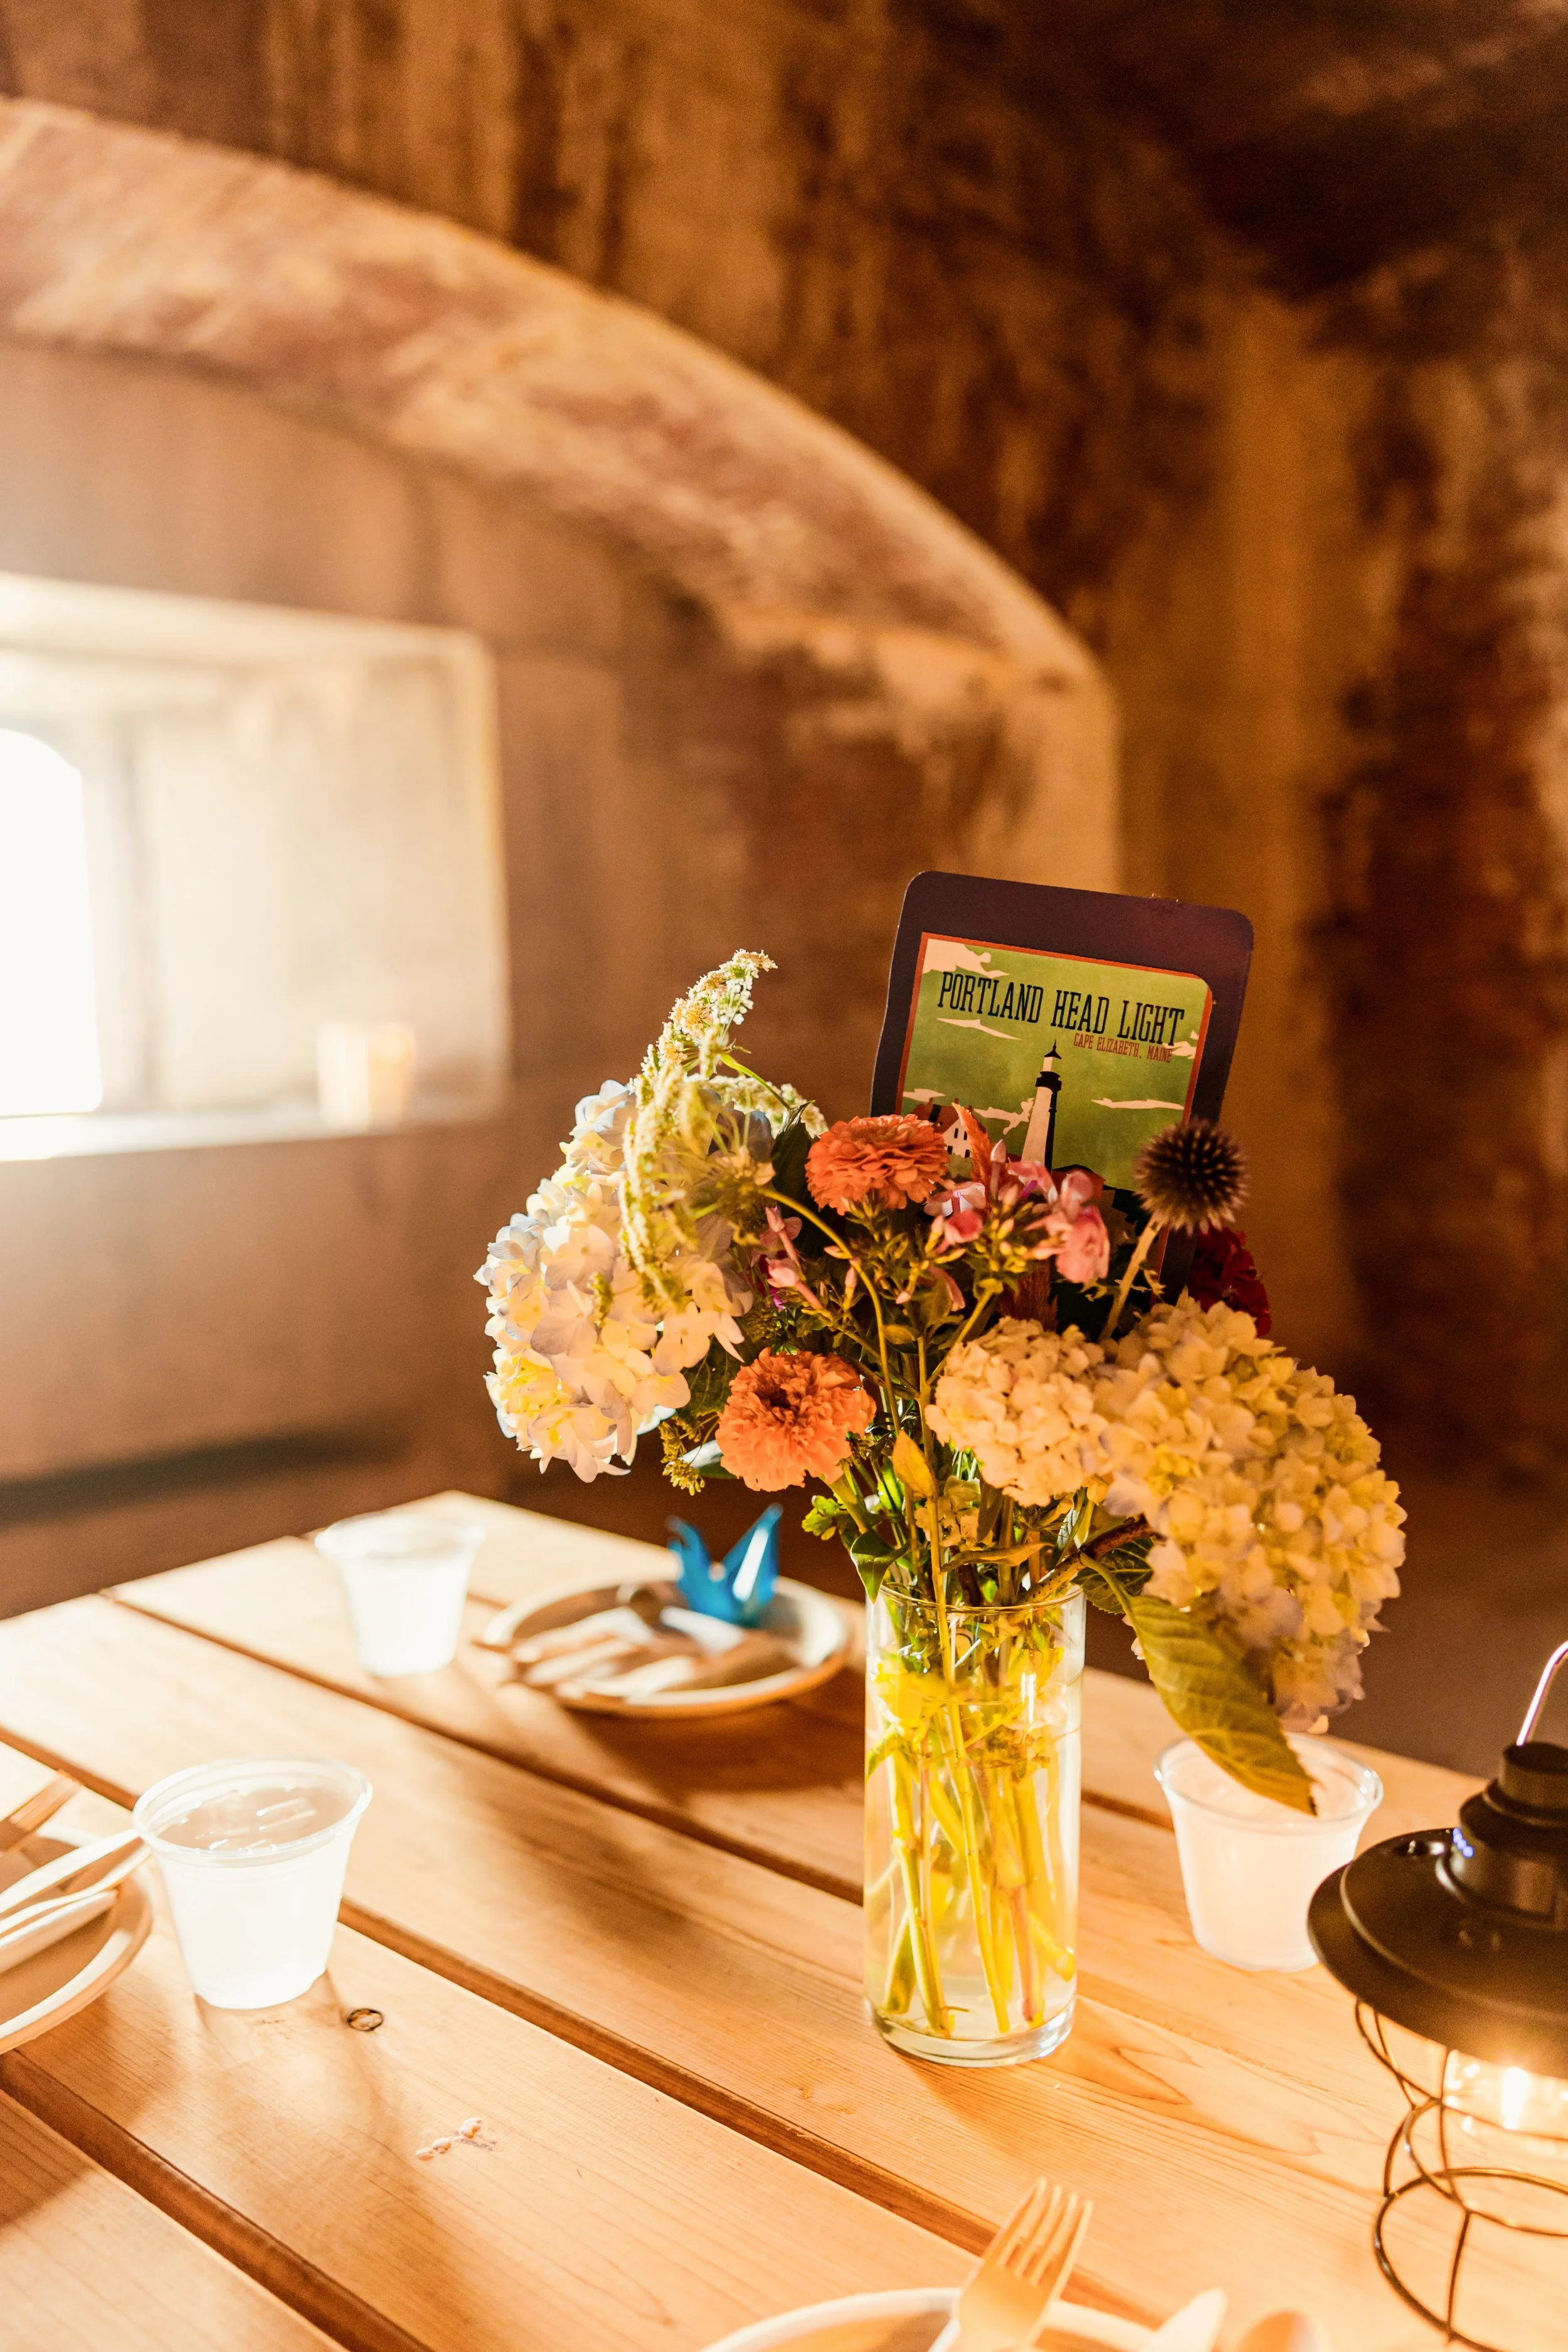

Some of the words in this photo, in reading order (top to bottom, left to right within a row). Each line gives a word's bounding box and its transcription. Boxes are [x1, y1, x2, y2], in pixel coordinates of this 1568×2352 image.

[937, 972, 1044, 1023] PORTLAND
[1051, 990, 1110, 1034] HEAD
[1117, 1000, 1185, 1046] LIGHT
[1074, 1033, 1094, 1049] CAPE
[1096, 1037, 1142, 1059] ELIZABETH,
[1147, 1045, 1173, 1062] MAINE
